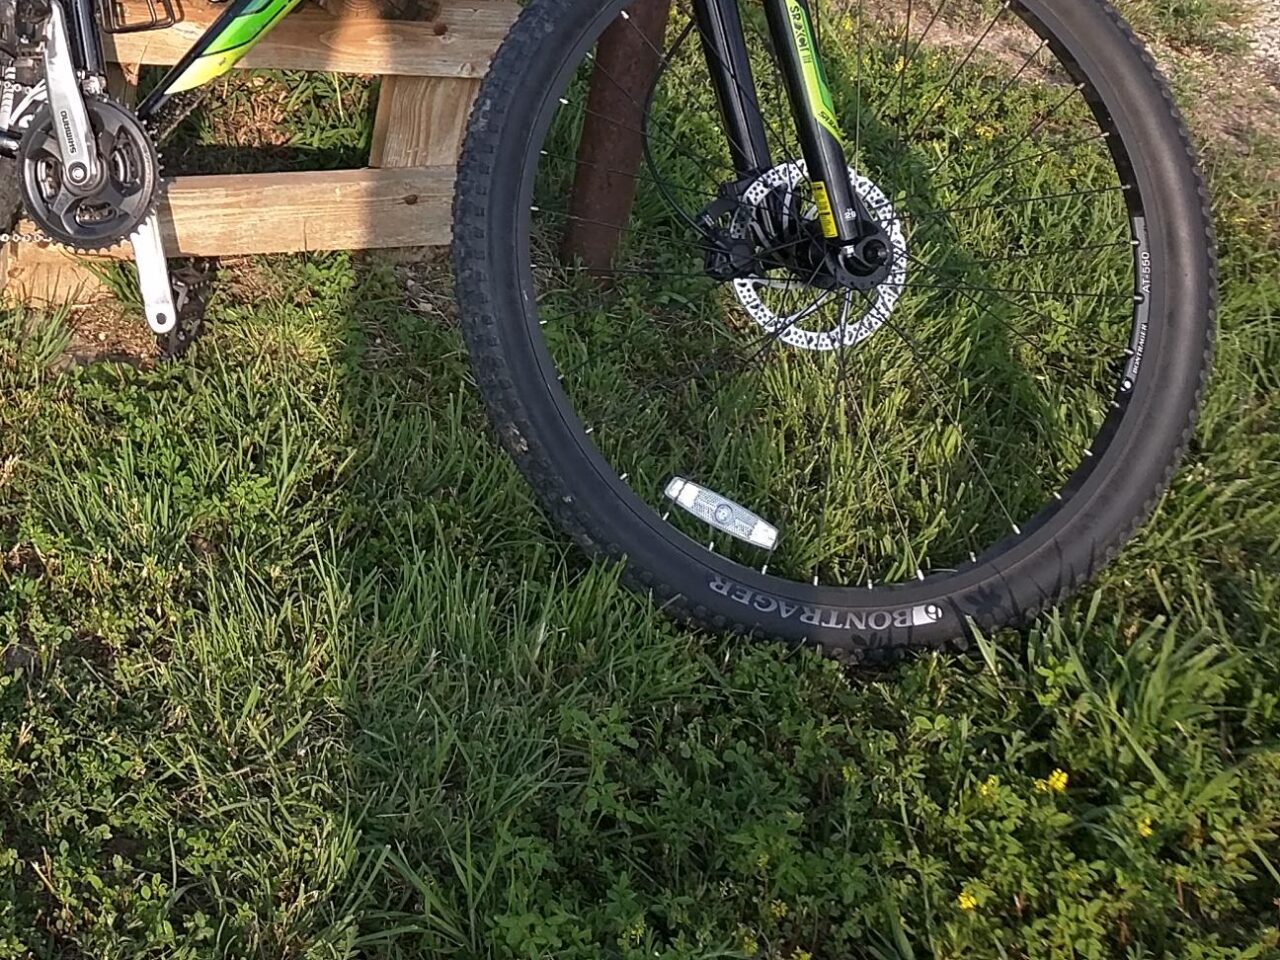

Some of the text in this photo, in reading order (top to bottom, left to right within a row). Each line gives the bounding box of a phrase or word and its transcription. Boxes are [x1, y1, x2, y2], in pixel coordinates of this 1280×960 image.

[60, 110, 77, 154] SHIMANO
[1132, 251, 1151, 374] BONTRAGER AT-550
[708, 575, 915, 631] BONTRAGER
